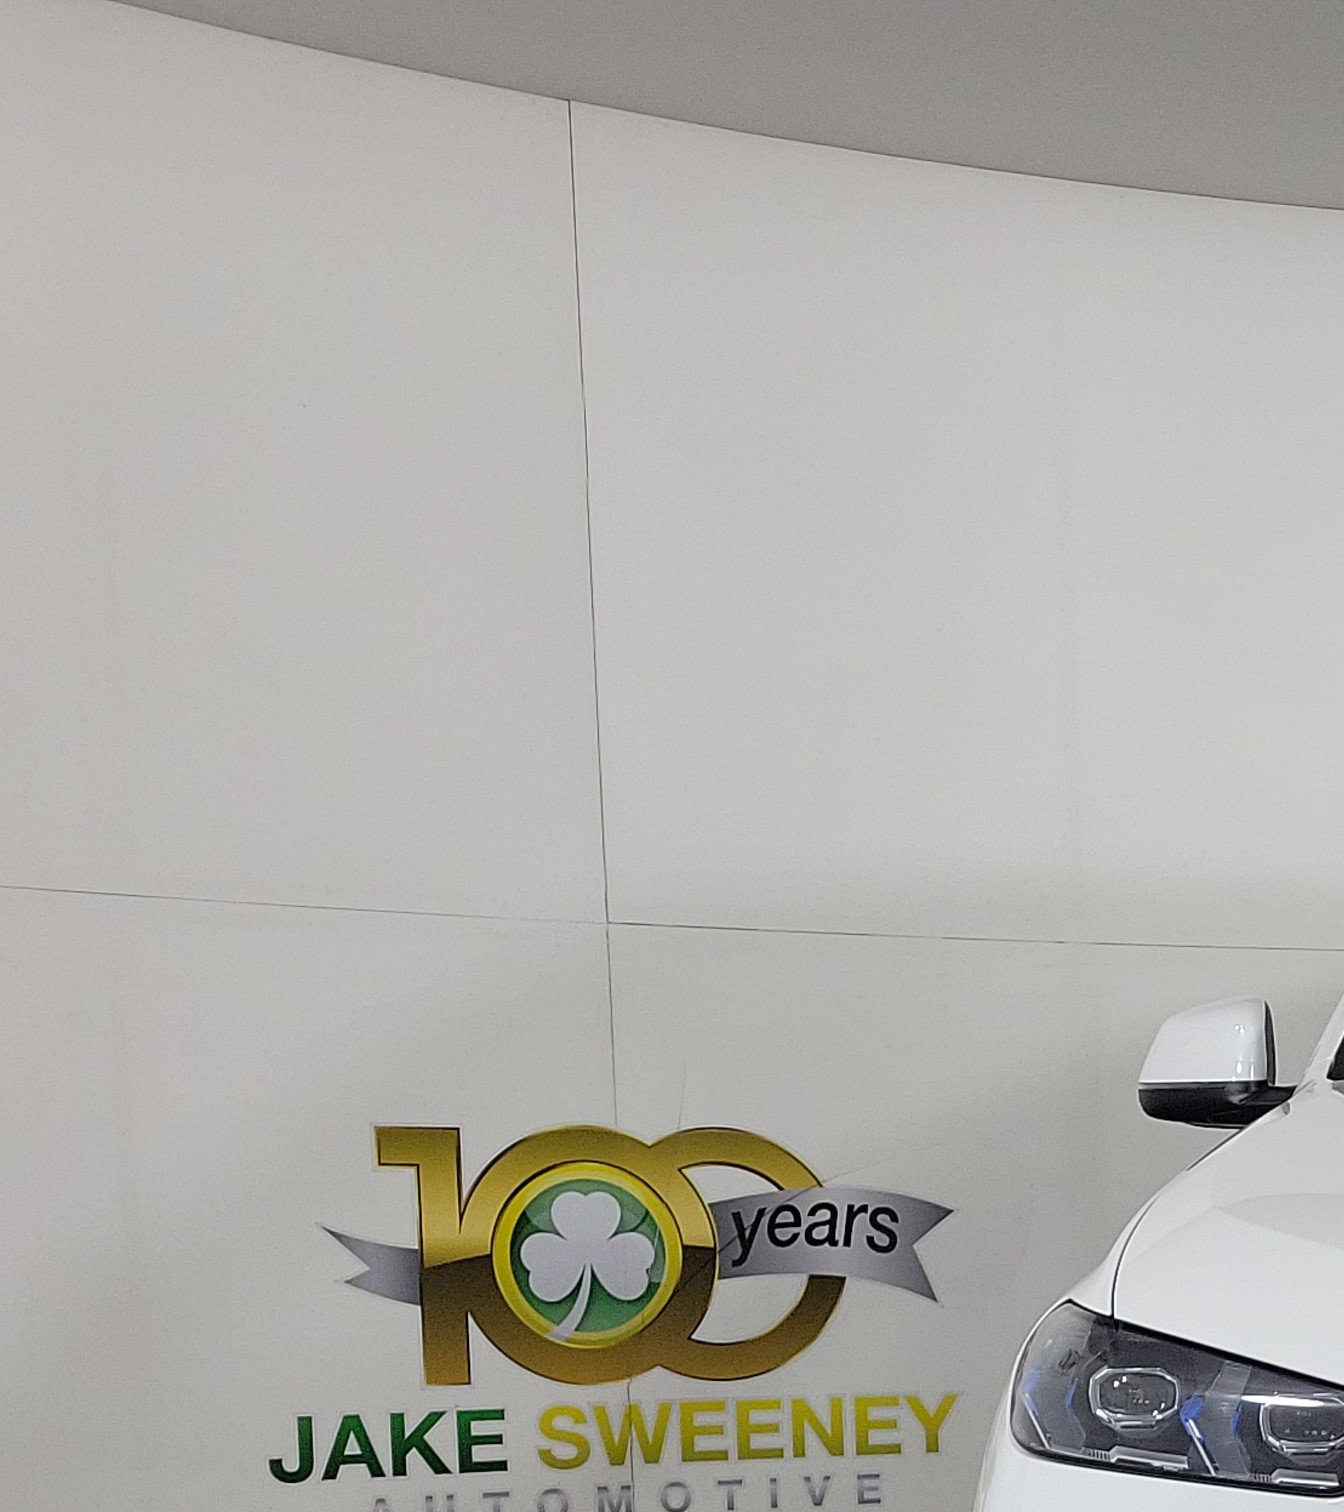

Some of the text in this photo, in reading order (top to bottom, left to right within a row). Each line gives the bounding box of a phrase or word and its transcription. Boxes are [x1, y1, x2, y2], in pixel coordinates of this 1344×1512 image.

[374, 1125, 846, 1386] 100
[731, 1202, 899, 1268] years
[269, 1394, 956, 1483] JAKE SWEENEY
